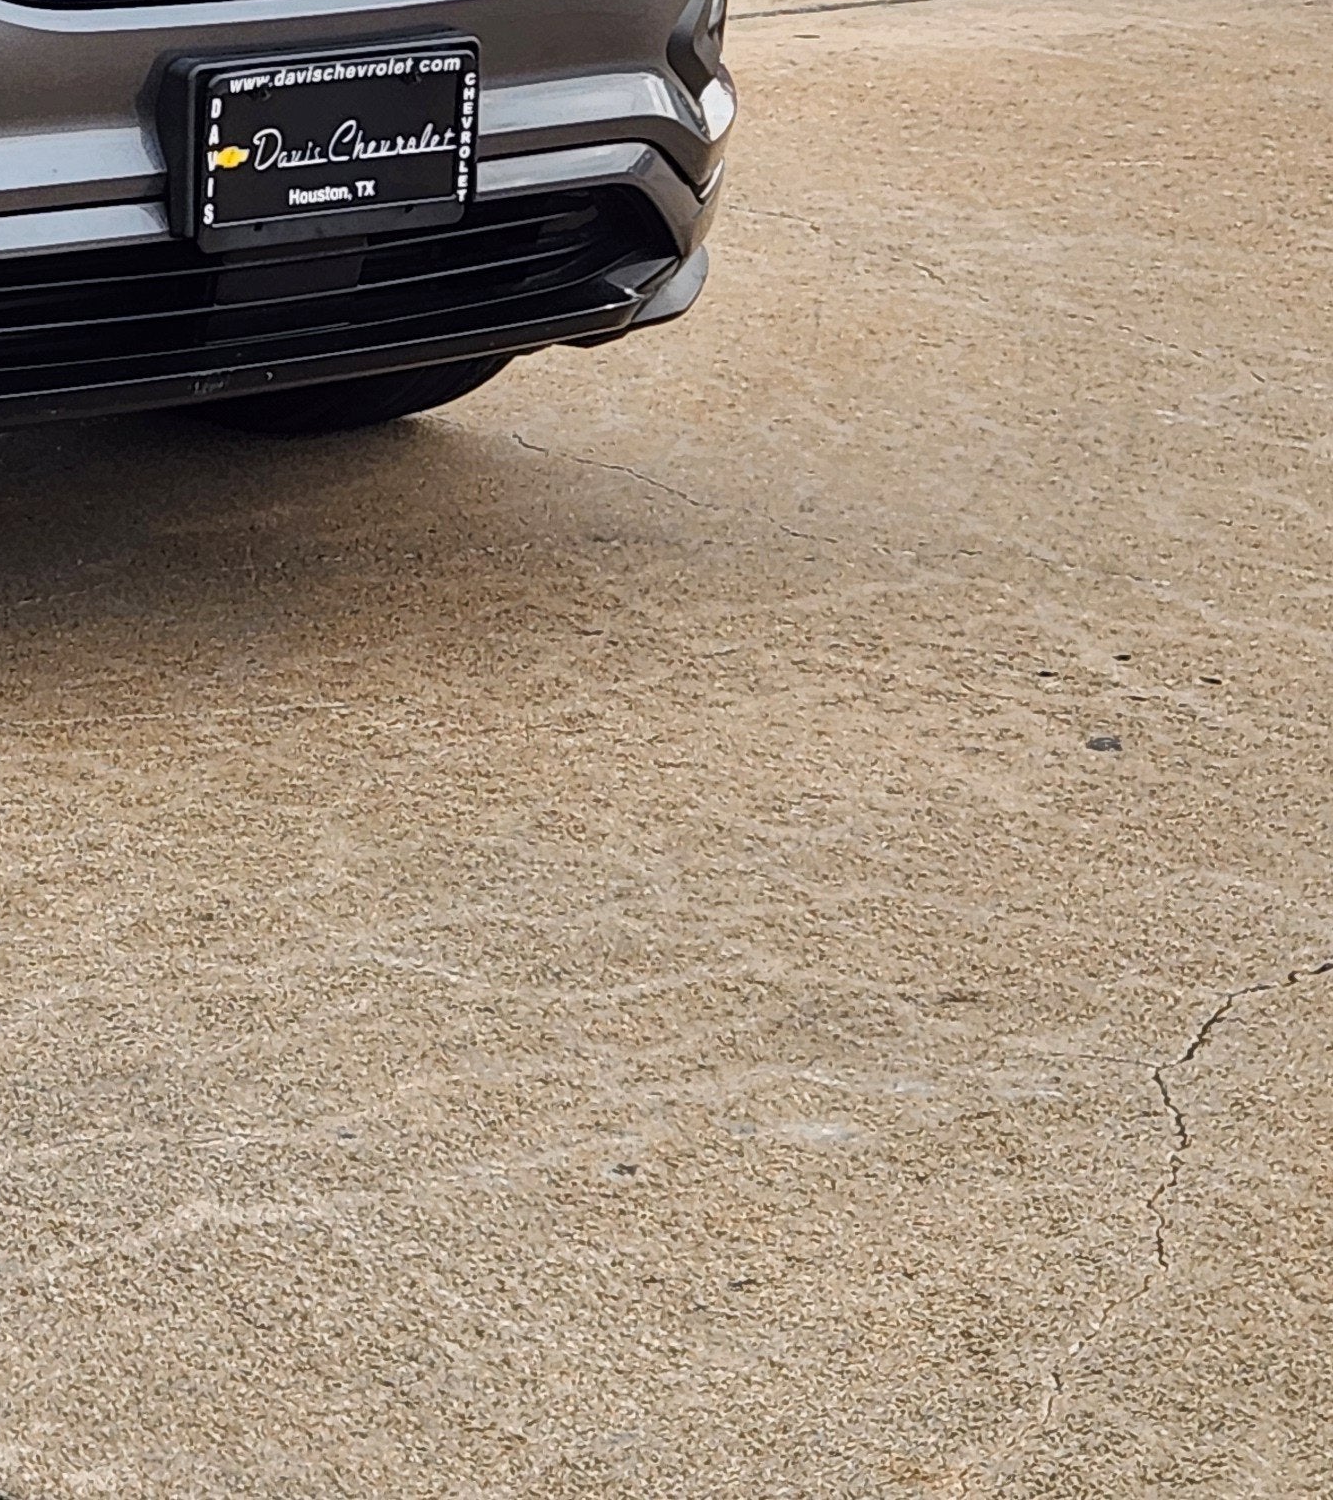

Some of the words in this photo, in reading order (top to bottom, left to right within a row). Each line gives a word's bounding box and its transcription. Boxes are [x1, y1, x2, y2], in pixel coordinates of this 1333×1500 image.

[229, 57, 461, 94] www.davischevroletcom
[202, 97, 223, 226] DAVIS
[252, 127, 328, 171] Davis
[328, 119, 458, 162] Chevrolet
[456, 71, 477, 203] CHEVROLET
[288, 184, 353, 206] Houston,
[354, 179, 376, 198] TX
